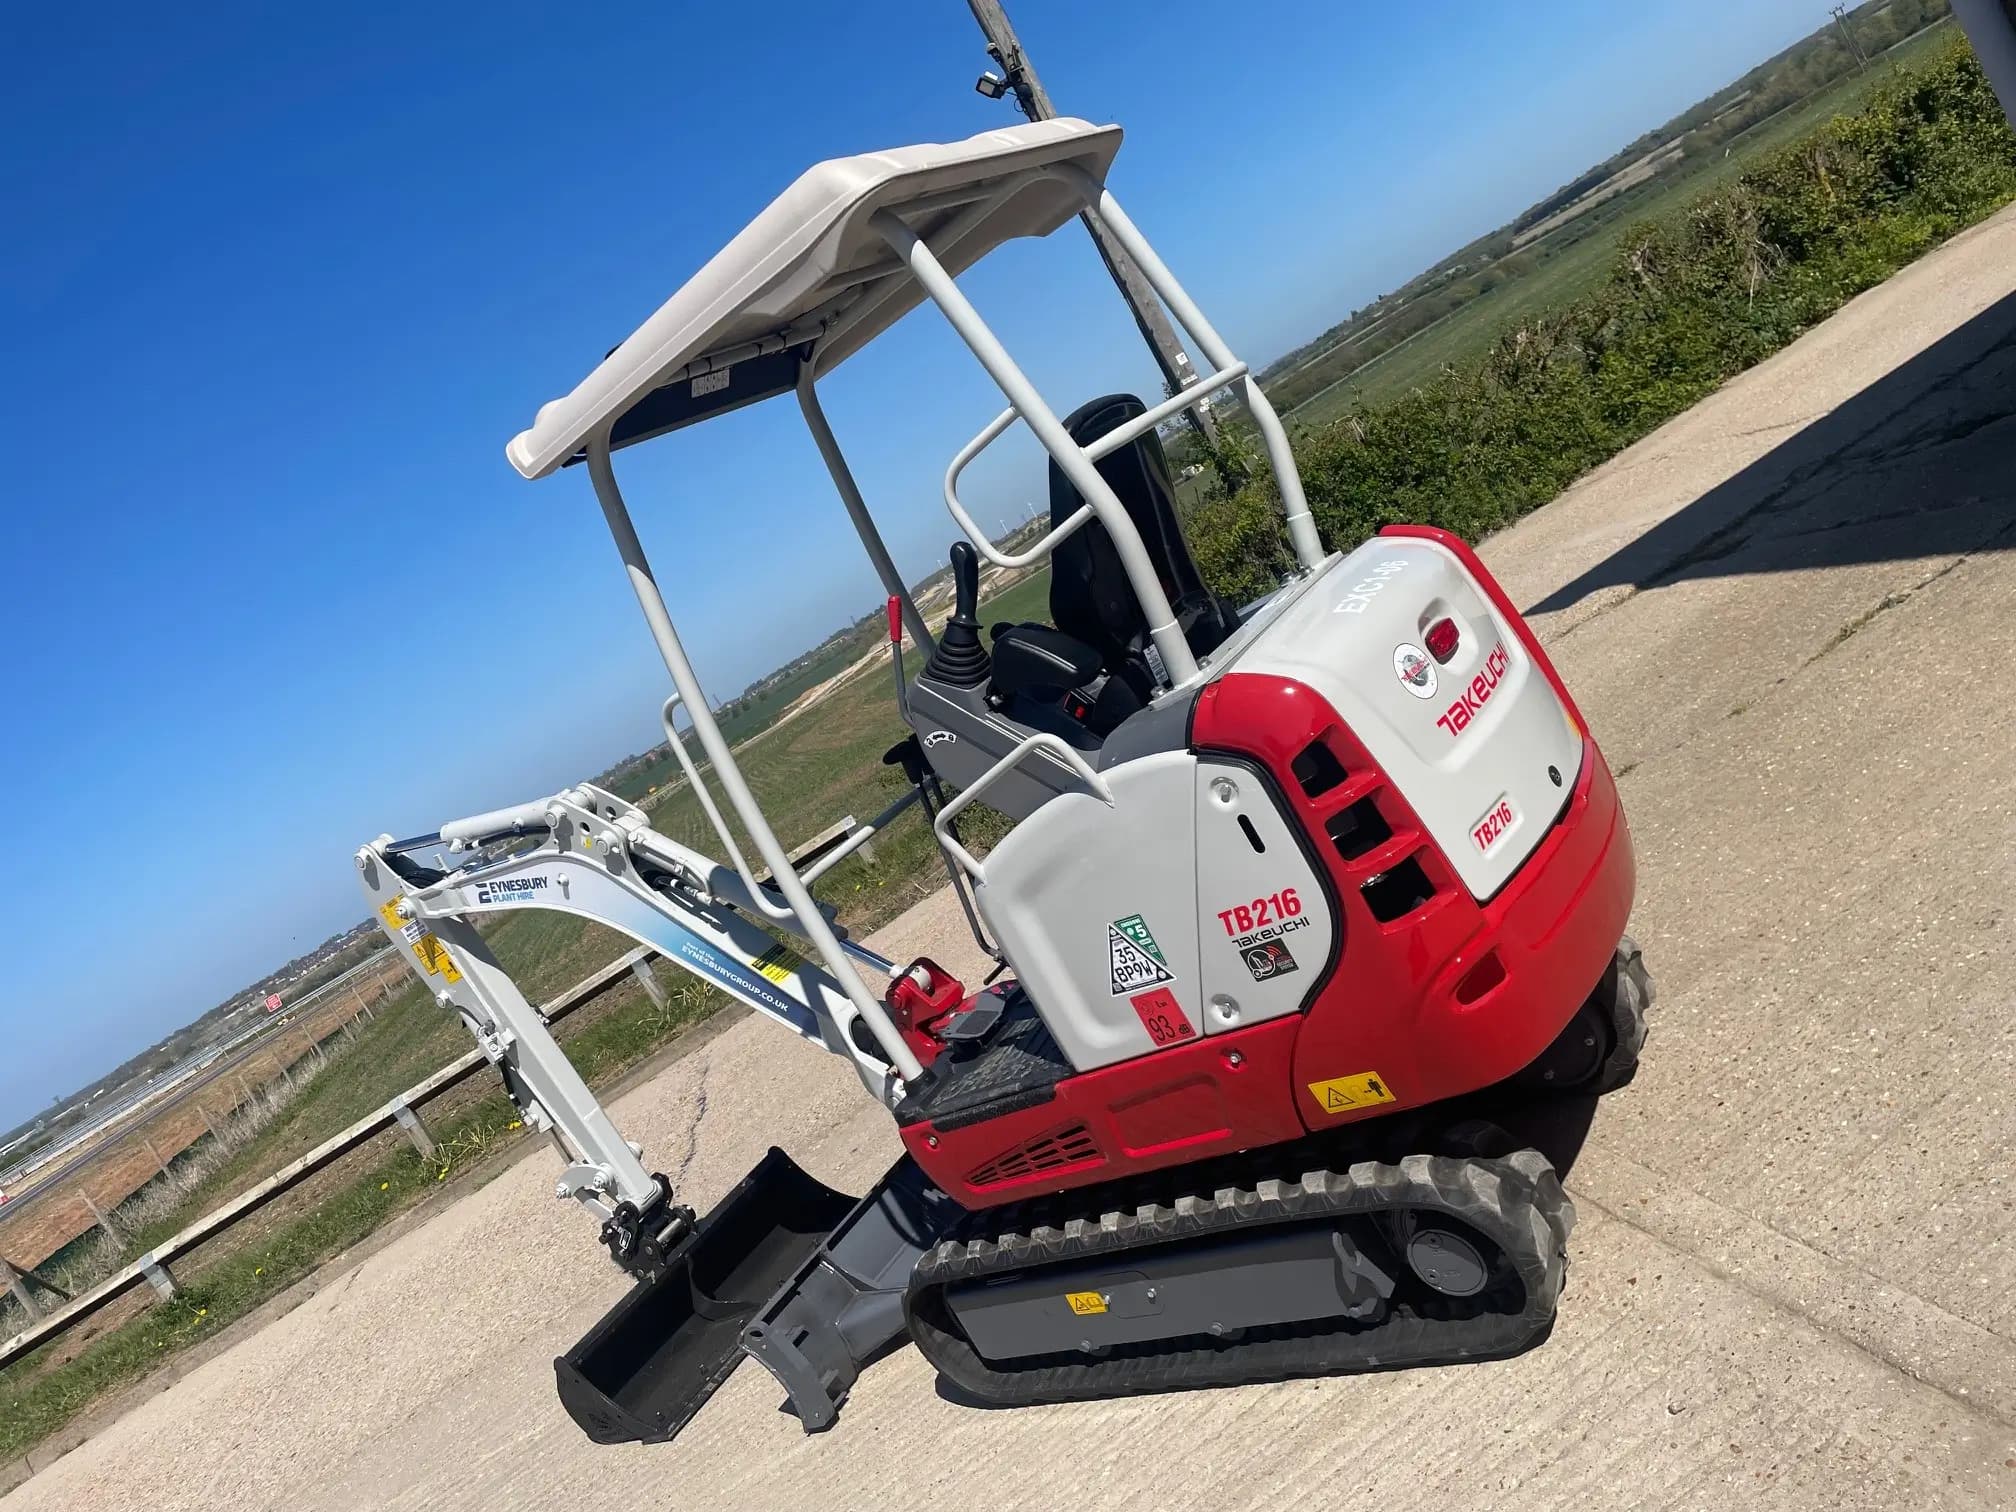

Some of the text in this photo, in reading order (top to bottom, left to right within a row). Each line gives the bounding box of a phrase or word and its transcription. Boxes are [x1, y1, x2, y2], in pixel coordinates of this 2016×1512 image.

[1436, 640, 1510, 737] TAKEUCHI
[1473, 802, 1512, 851] TB216
[489, 876, 548, 893] EYNESBURY
[492, 890, 535, 903] PLANT HIRE
[1217, 888, 1302, 937] TB216
[1134, 924, 1147, 938] 5
[1231, 916, 1311, 948] TAKEUCHI
[1114, 946, 1136, 964] 35
[682, 945, 789, 1012] EYNESBURYGROUP.CO.UK
[1114, 959, 1154, 983] BP9W
[1148, 1015, 1176, 1041] 93
